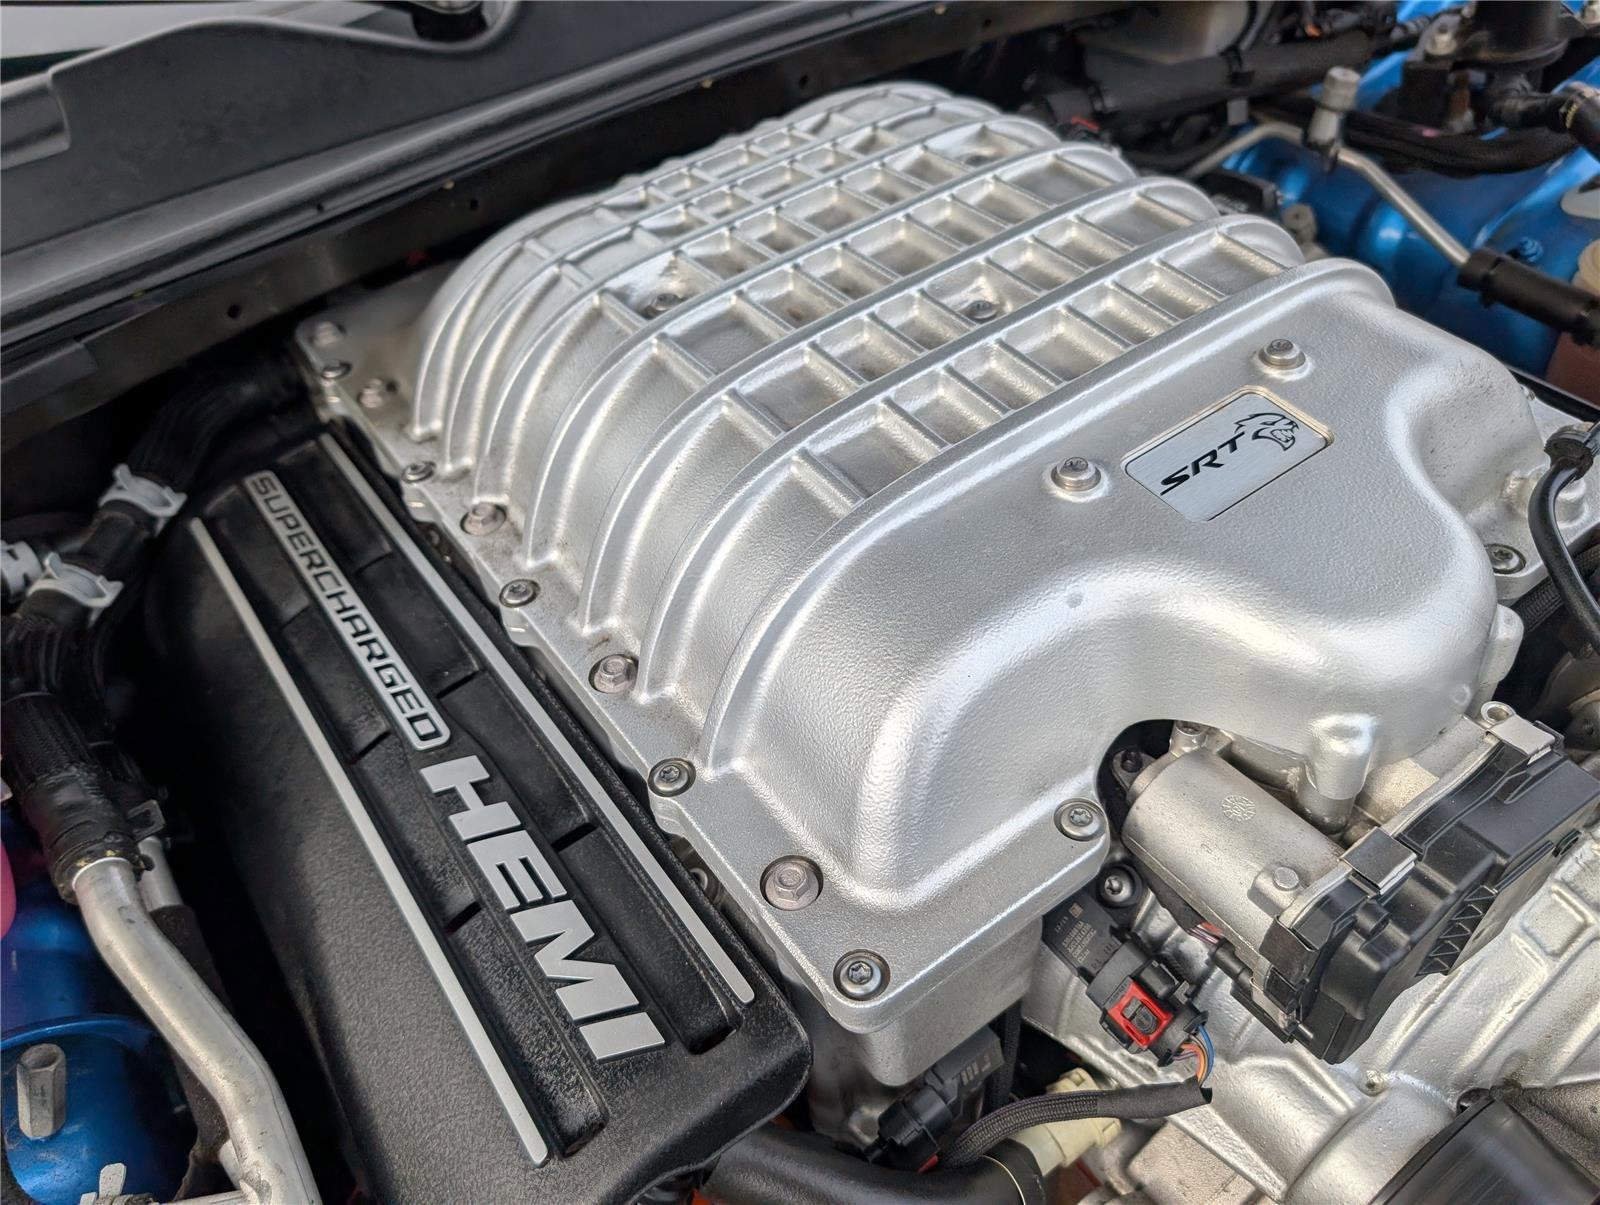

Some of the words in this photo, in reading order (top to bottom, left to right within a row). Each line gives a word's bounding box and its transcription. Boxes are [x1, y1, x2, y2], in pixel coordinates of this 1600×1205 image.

[1160, 431, 1245, 496] SRT
[251, 475, 443, 742] SUPERCHARGED
[420, 755, 665, 1060] HEMI
